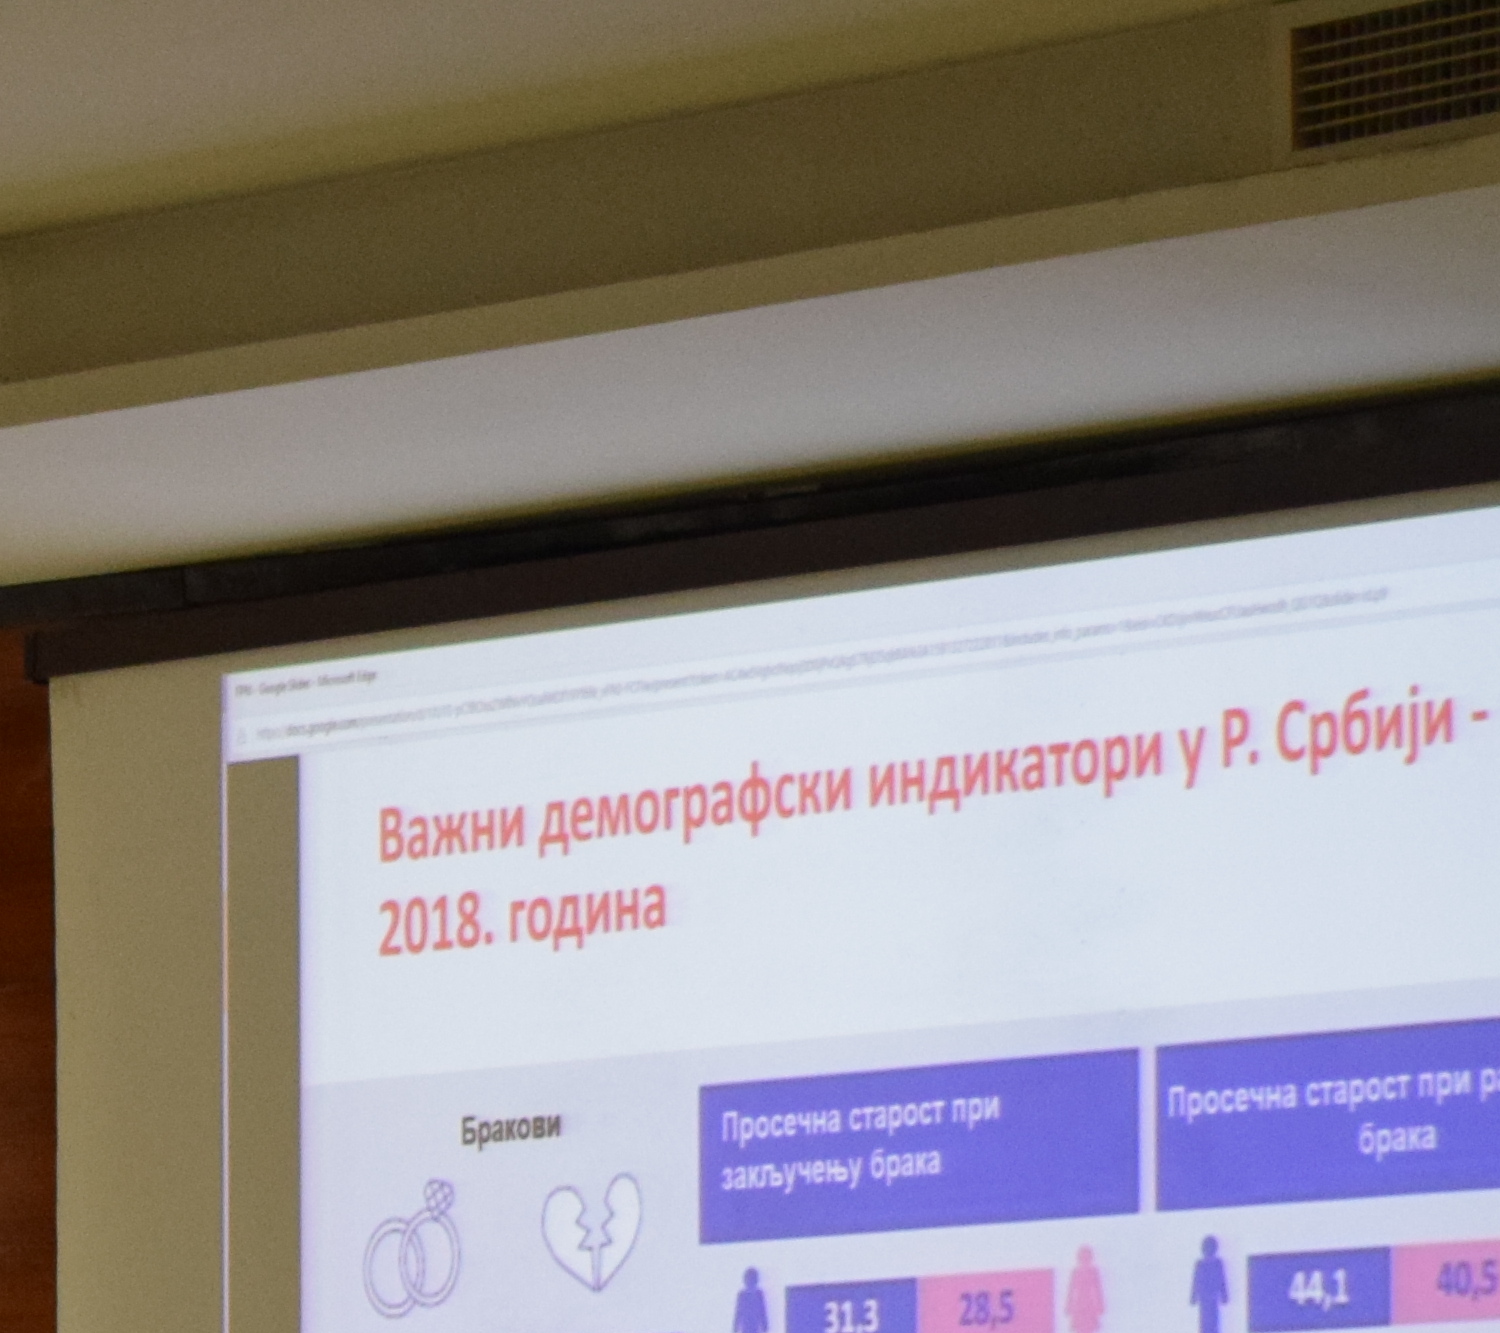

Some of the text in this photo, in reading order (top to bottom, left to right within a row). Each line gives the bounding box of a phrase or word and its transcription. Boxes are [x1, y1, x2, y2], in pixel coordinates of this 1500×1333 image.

[379, 804, 525, 863] Важни
[538, 760, 853, 858] демографски
[869, 730, 1163, 815] индикатори
[1179, 726, 1206, 789] у
[1222, 708, 1259, 768] Р.
[1276, 684, 1454, 775] Србији
[379, 882, 667, 956] 2018. година
[1168, 1085, 1298, 1124] Просечна
[1306, 1073, 1410, 1111] старост
[1418, 1068, 1471, 1105] при
[461, 1113, 562, 1151] Бракови
[721, 1095, 1001, 1149] Просечна старост при
[1358, 1122, 1438, 1161] брака
[721, 1148, 941, 1195] закључењу брака
[1288, 1268, 1350, 1312] 44,1
[1436, 1259, 1498, 1302] 40,5
[958, 1289, 1015, 1330] 28,5
